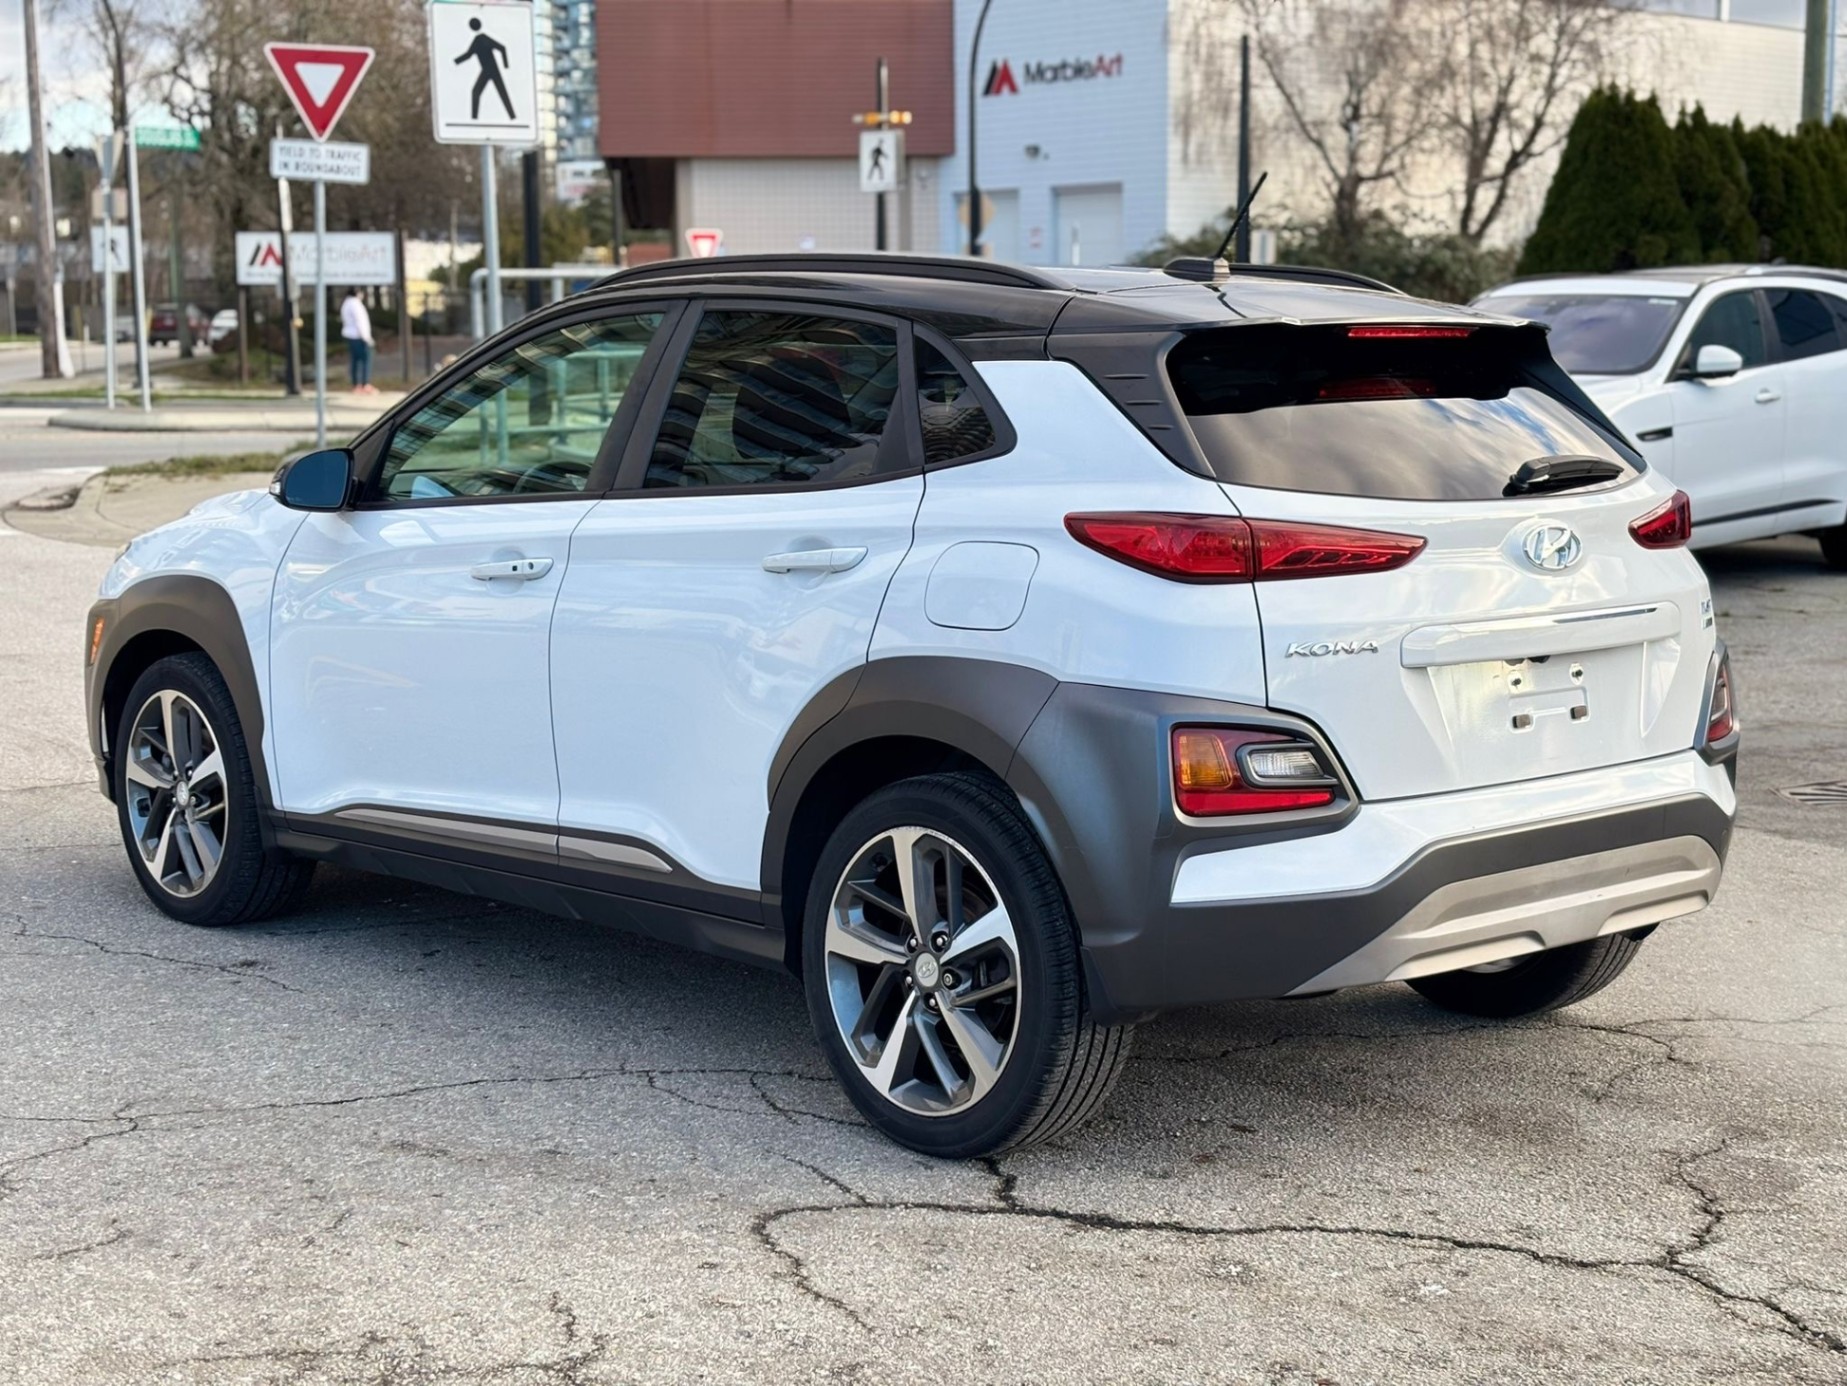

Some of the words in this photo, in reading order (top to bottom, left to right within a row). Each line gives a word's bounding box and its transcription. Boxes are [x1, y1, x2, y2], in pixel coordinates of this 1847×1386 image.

[1024, 53, 1123, 84] MarbleArt
[279, 146, 304, 157] YIELD
[309, 147, 322, 158] TO
[326, 149, 363, 161] TRAFFIC
[279, 161, 290, 171] IN
[295, 162, 362, 177] ROUNDABOUT
[288, 244, 386, 263] MableArt
[1285, 640, 1379, 658] KONA
